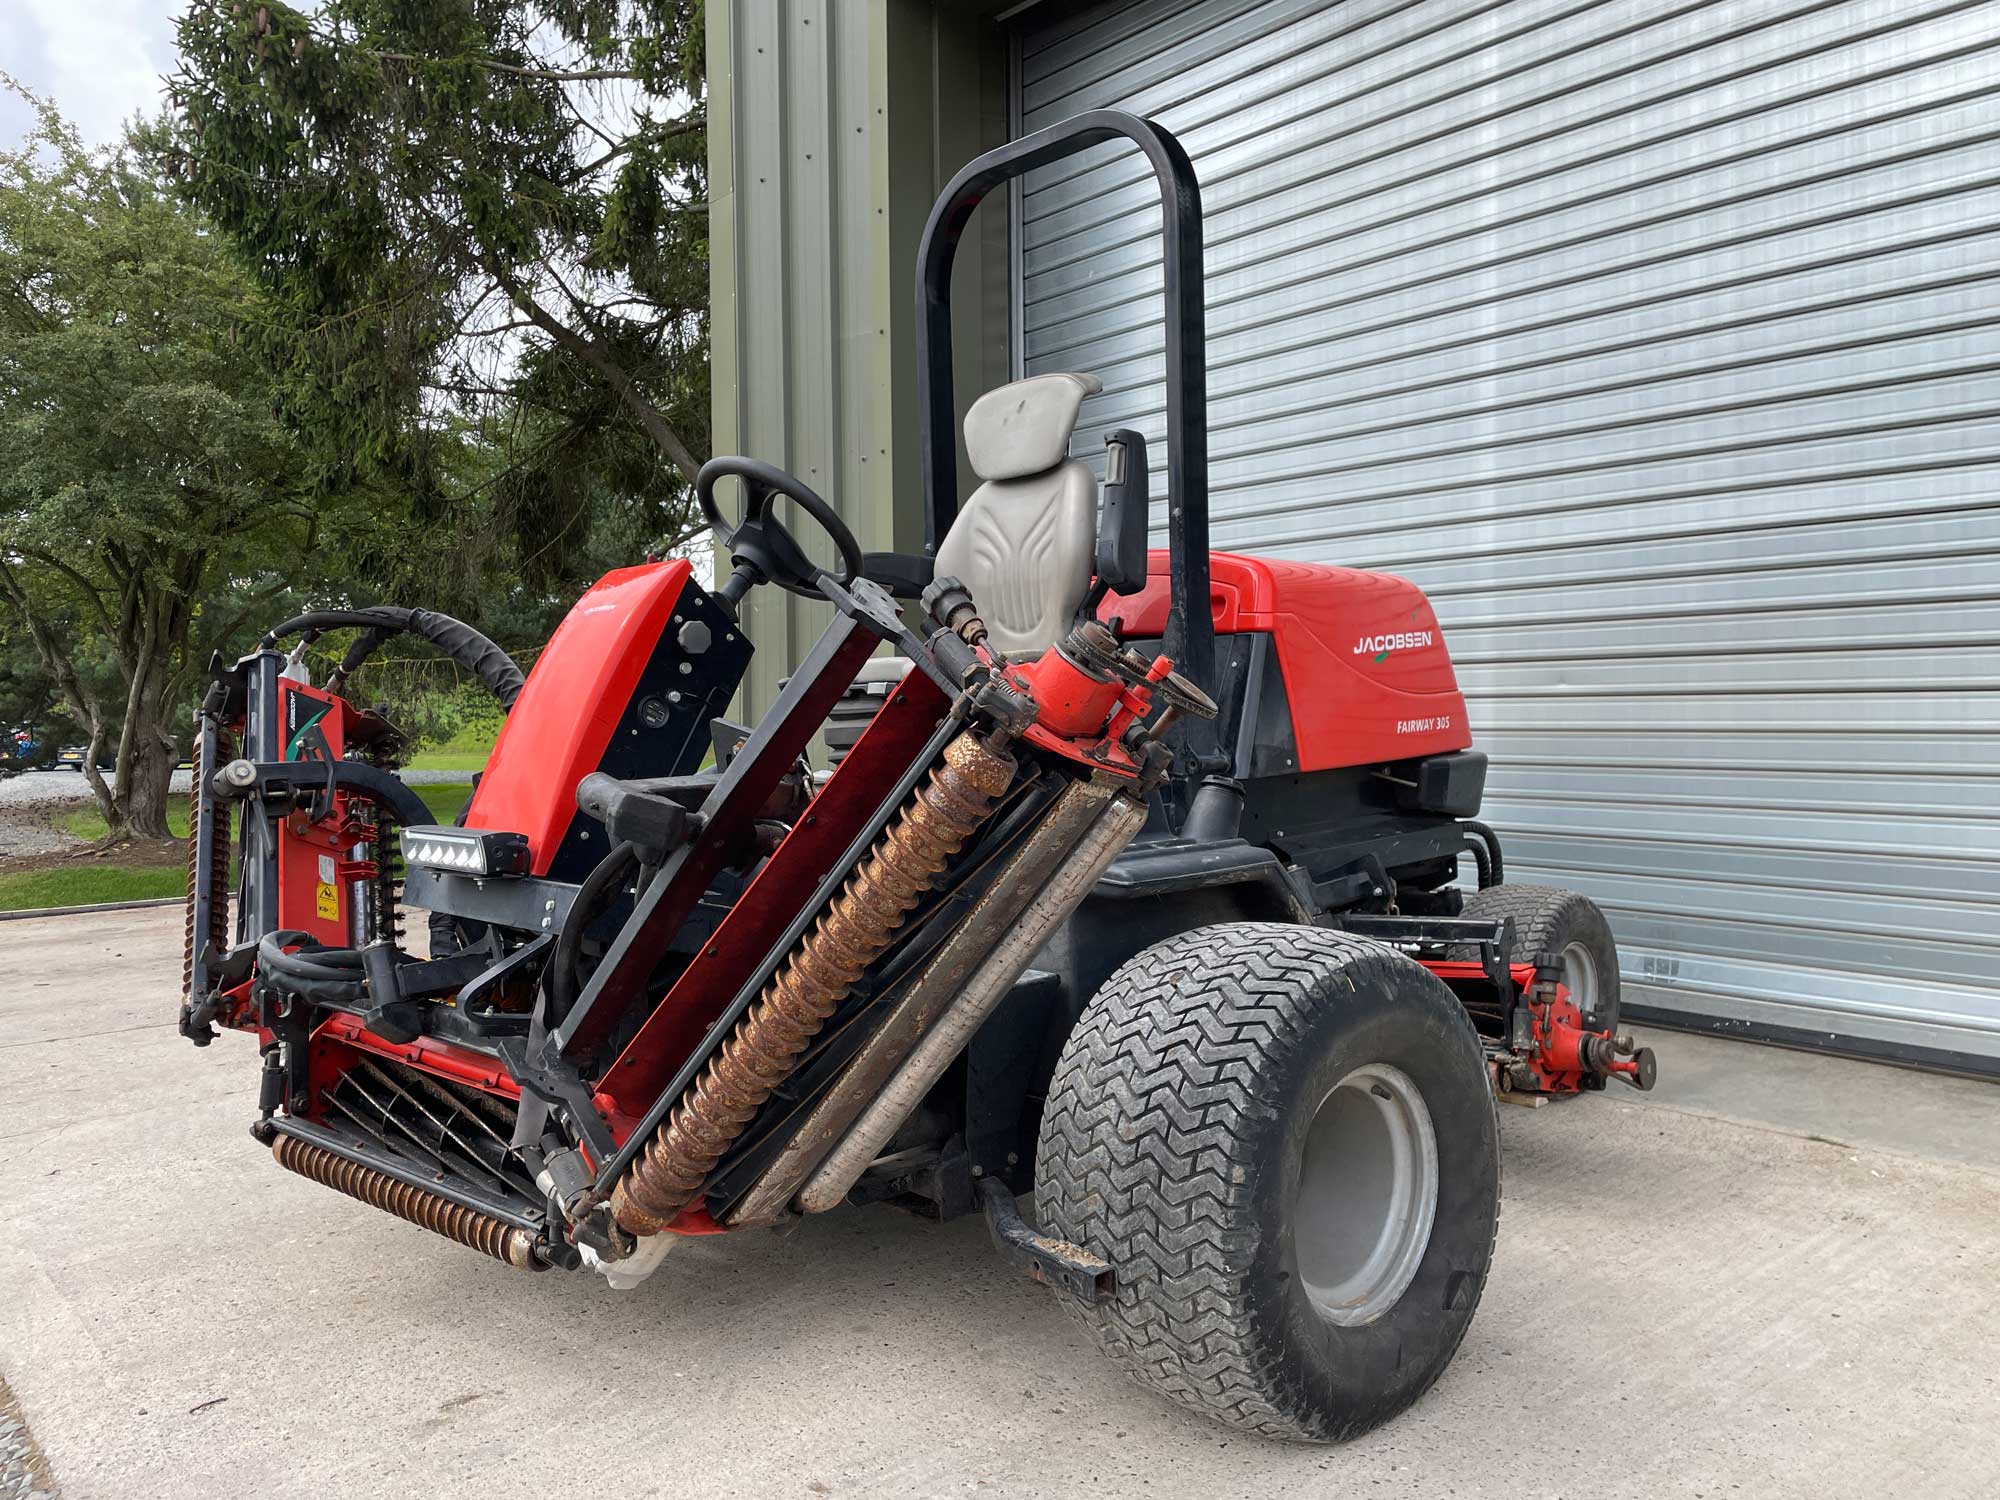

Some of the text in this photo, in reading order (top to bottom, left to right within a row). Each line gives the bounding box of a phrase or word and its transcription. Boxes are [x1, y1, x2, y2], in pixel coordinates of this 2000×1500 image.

[1353, 631, 1432, 655] JACOBSEN
[1397, 716, 1450, 734] FAIRWAY 305
